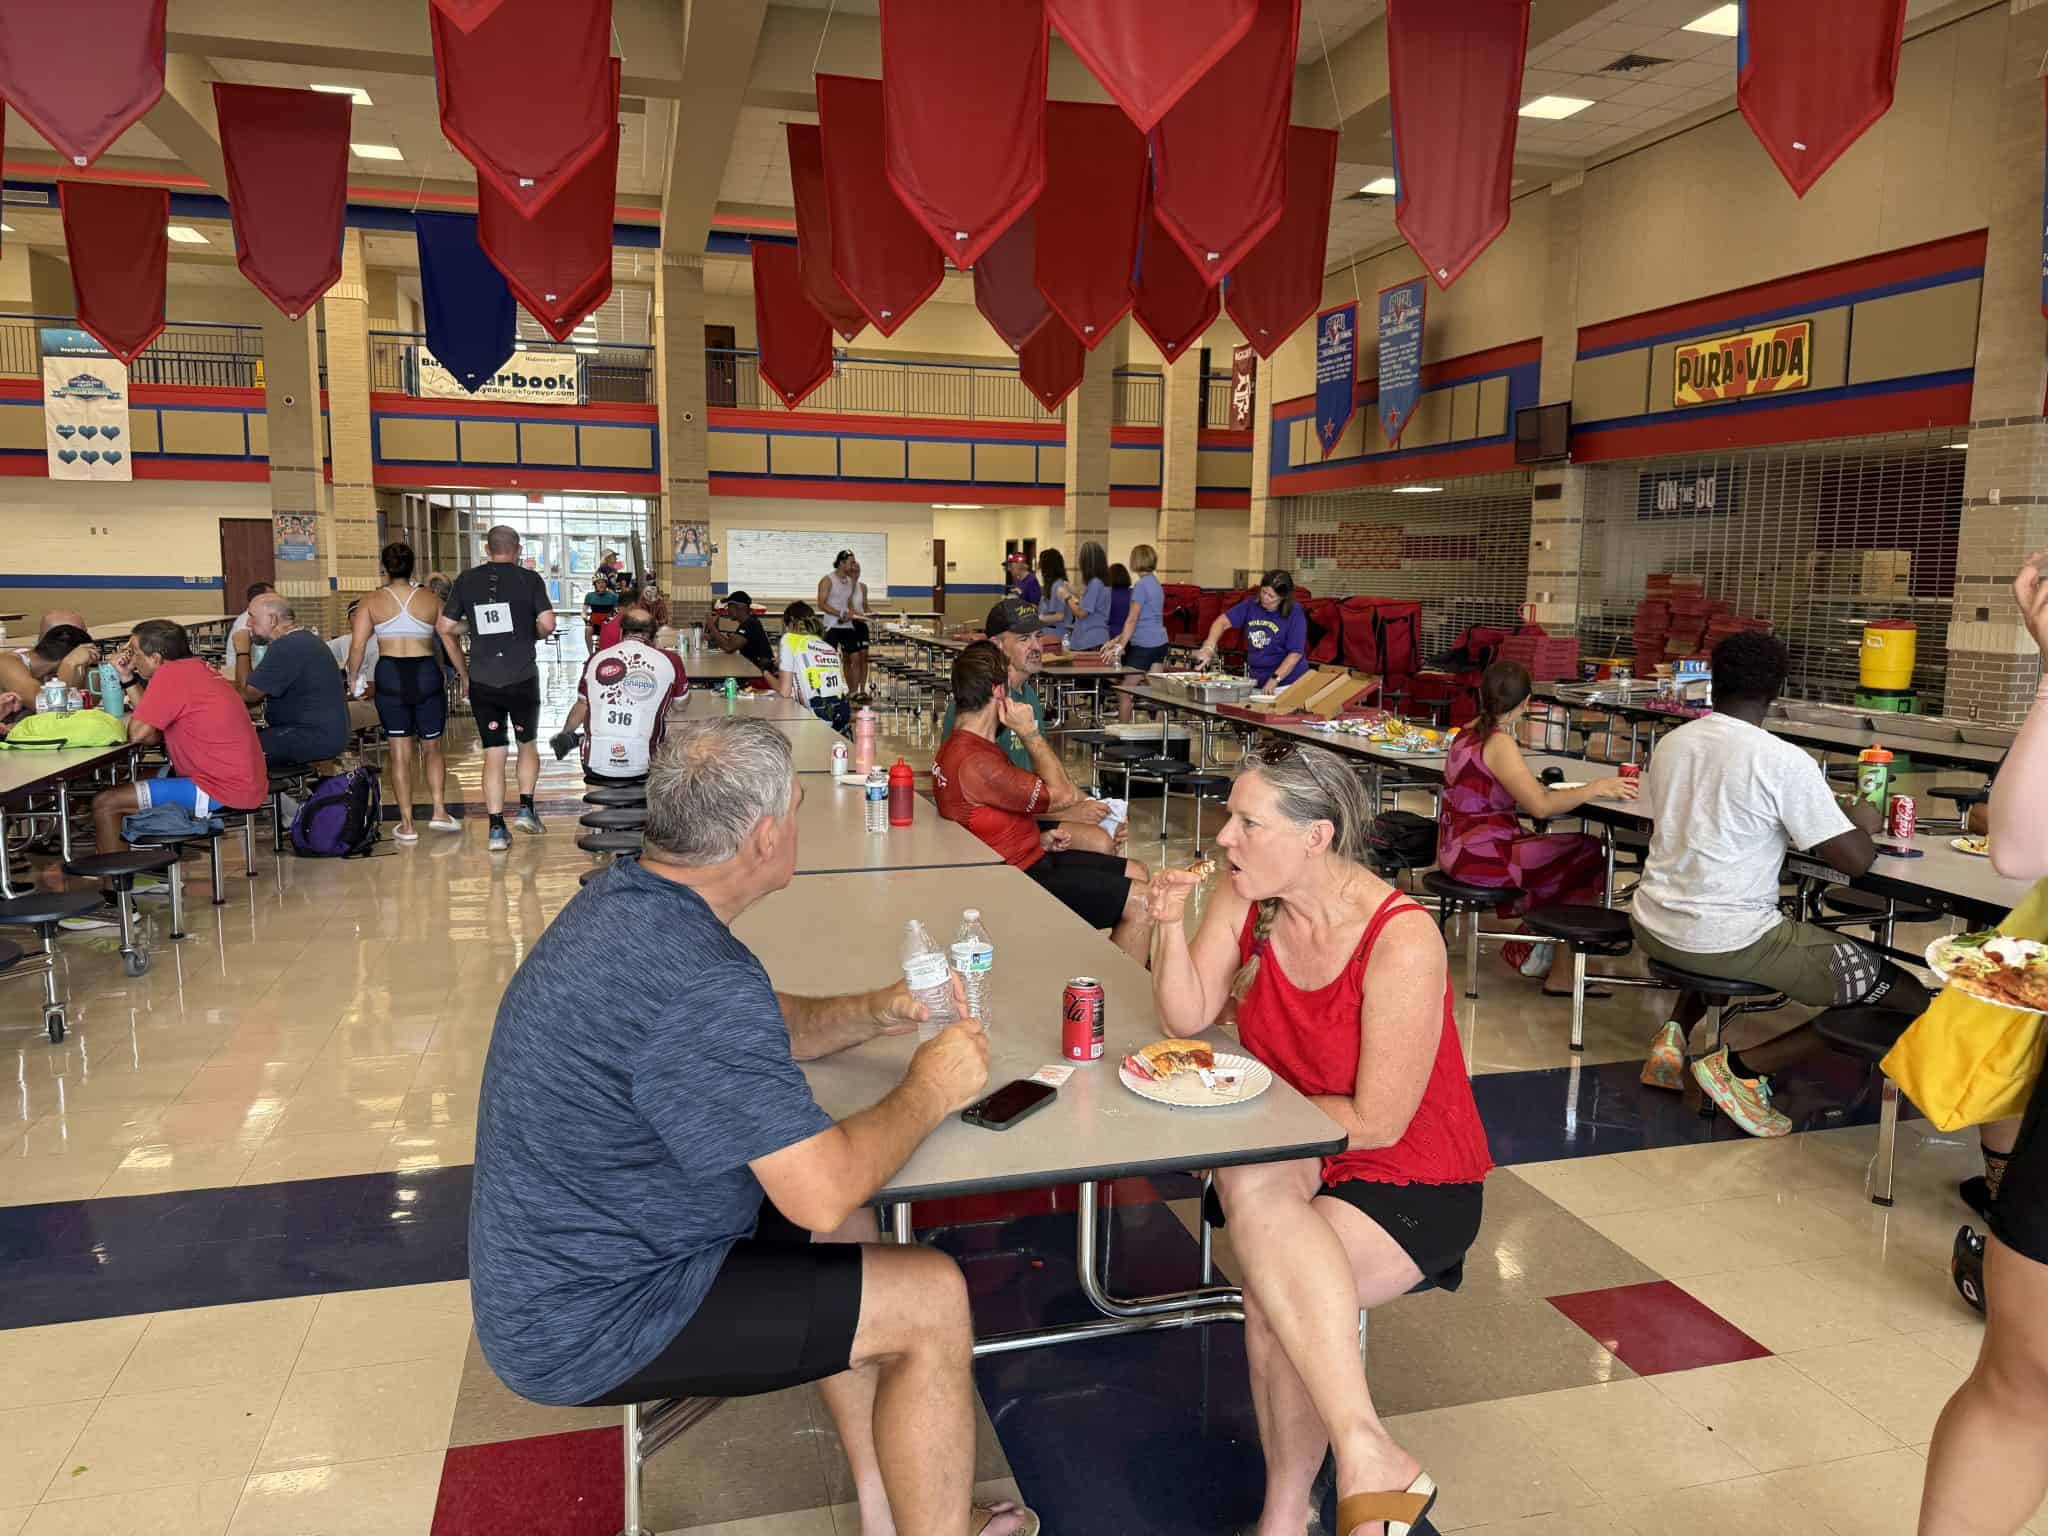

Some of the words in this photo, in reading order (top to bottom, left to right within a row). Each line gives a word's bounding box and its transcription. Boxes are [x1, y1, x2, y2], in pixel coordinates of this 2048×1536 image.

[1678, 350, 1734, 392] PURA
[1745, 336, 1804, 381] VIDA
[486, 372, 575, 390] arbook
[1658, 480, 1678, 510] ON
[1696, 477, 1716, 508] GO
[484, 609, 500, 624] 18
[607, 710, 633, 726] 316
